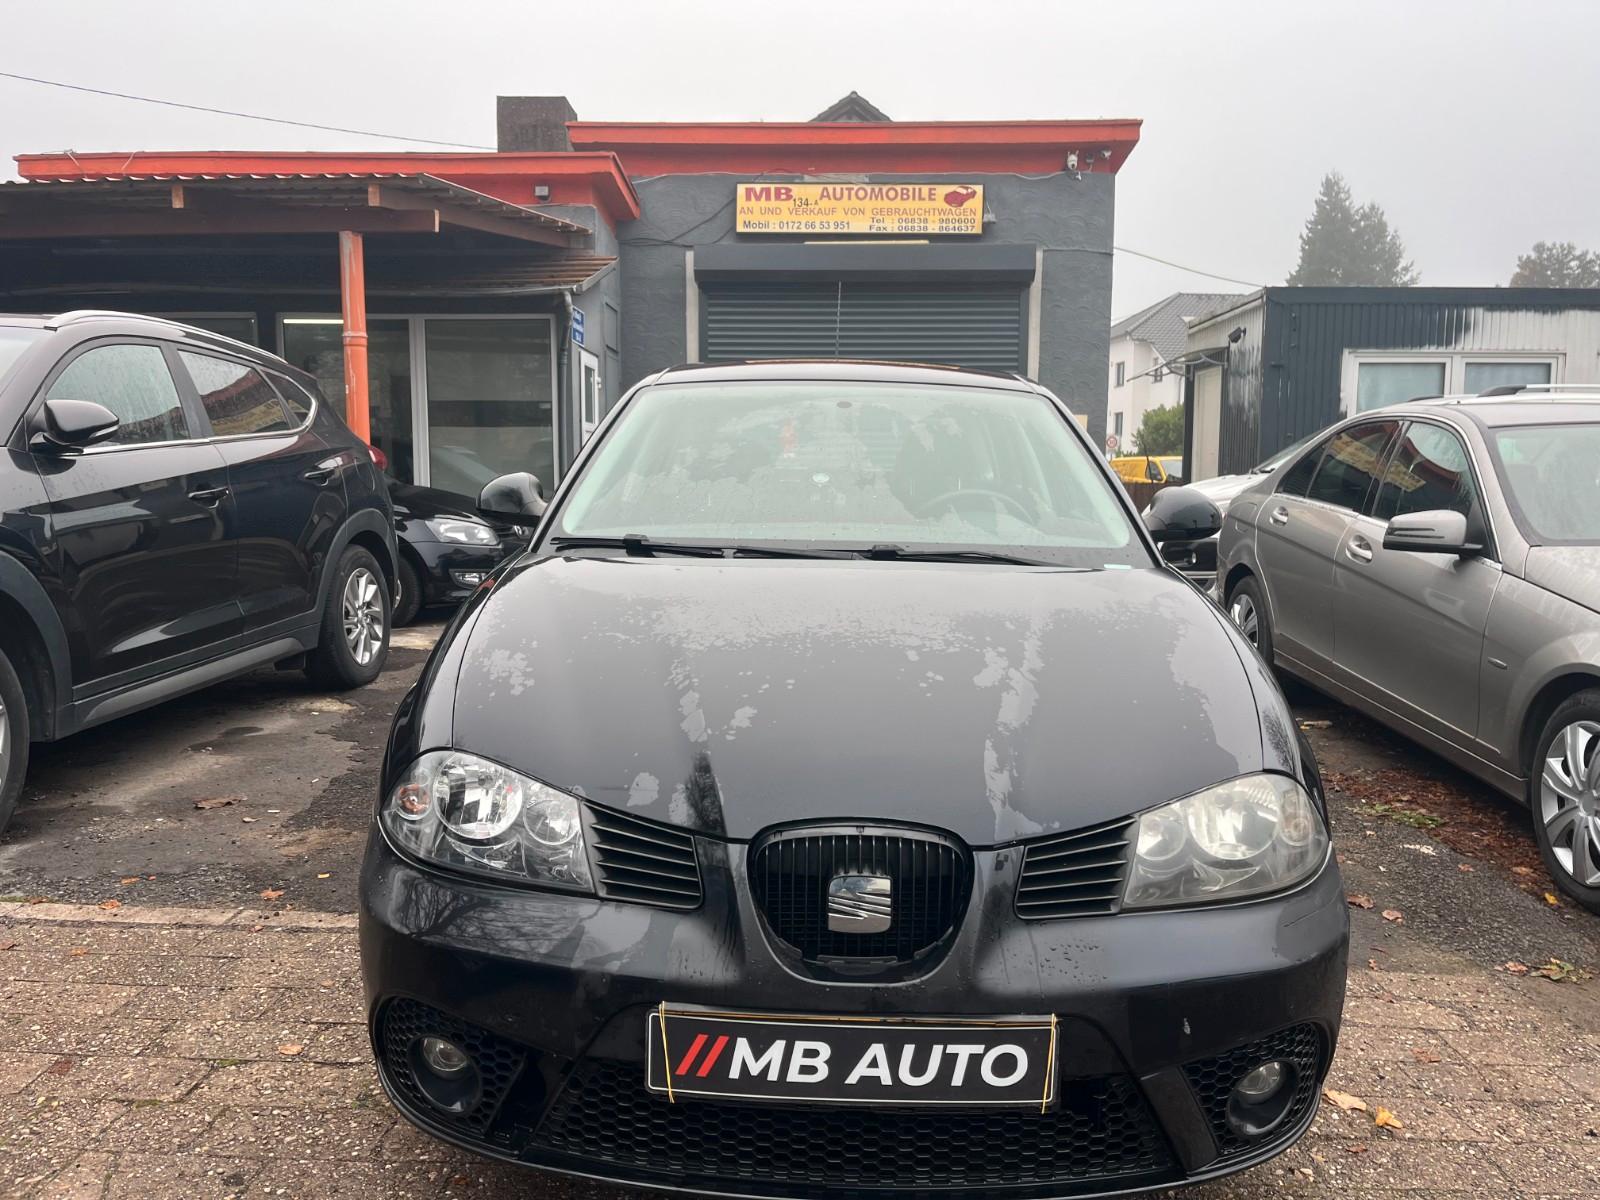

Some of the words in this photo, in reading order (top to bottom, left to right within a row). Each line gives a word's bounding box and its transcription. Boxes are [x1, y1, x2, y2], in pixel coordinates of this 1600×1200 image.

[745, 187, 794, 202] MB
[819, 186, 937, 201] AUTOMOBILE
[739, 207, 754, 215] AN
[760, 207, 782, 215] UND
[788, 207, 837, 216] VERKAUF
[843, 207, 865, 216] VON
[871, 207, 977, 216] GEBRAUCHTWAGEN
[743, 220, 770, 229] Mobil
[778, 221, 802, 230] 0172
[804, 221, 817, 229] 66
[819, 221, 831, 229] 53
[833, 221, 851, 230] 951
[844, 1043, 1029, 1087] AUTO
